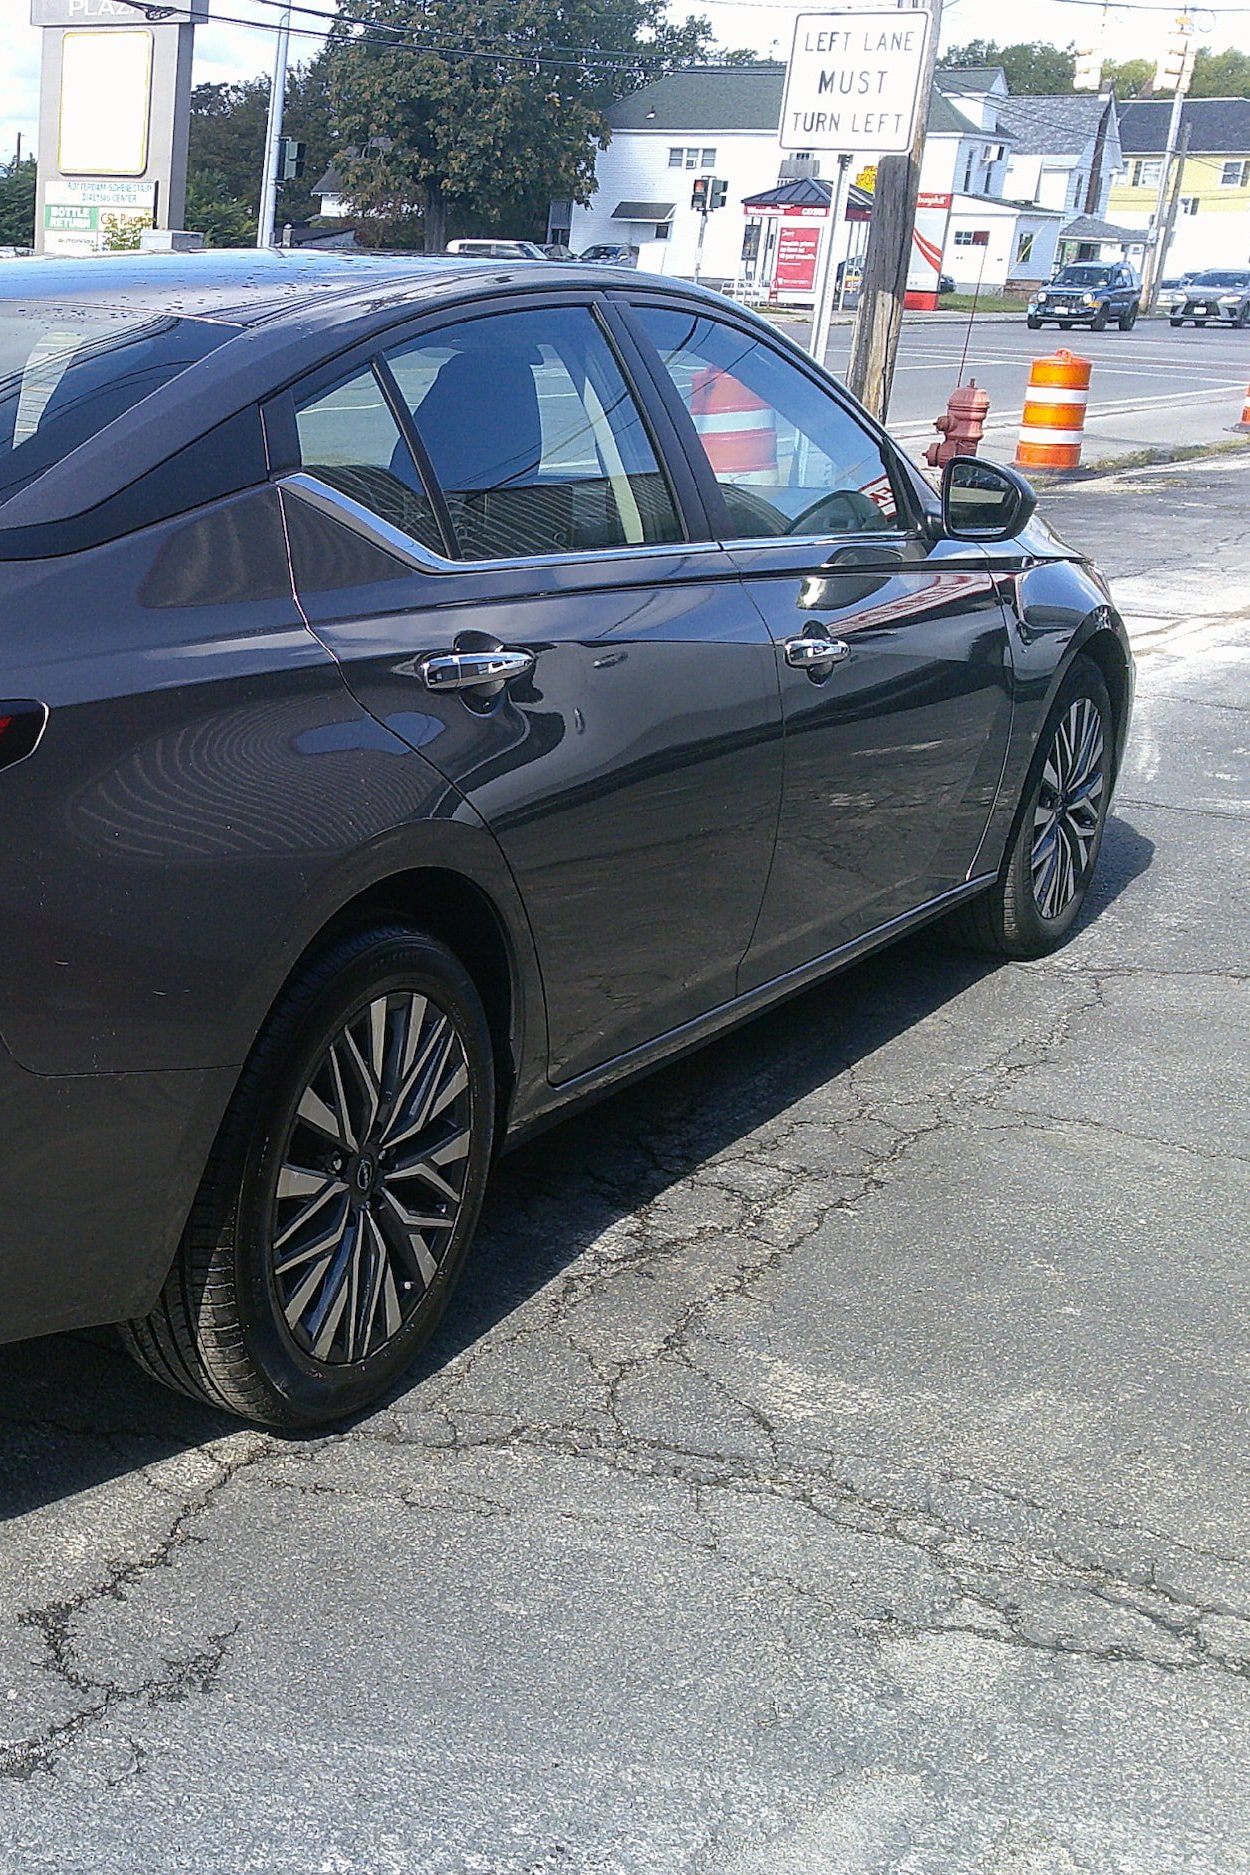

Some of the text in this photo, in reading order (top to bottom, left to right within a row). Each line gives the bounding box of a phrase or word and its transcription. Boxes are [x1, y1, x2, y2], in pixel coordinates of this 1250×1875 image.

[805, 32, 915, 51] LEFT LANE
[818, 70, 888, 94] MUST
[793, 112, 903, 133] TURN LEFT
[50, 206, 91, 217] BOTTLE
[49, 217, 91, 229] RETURN
